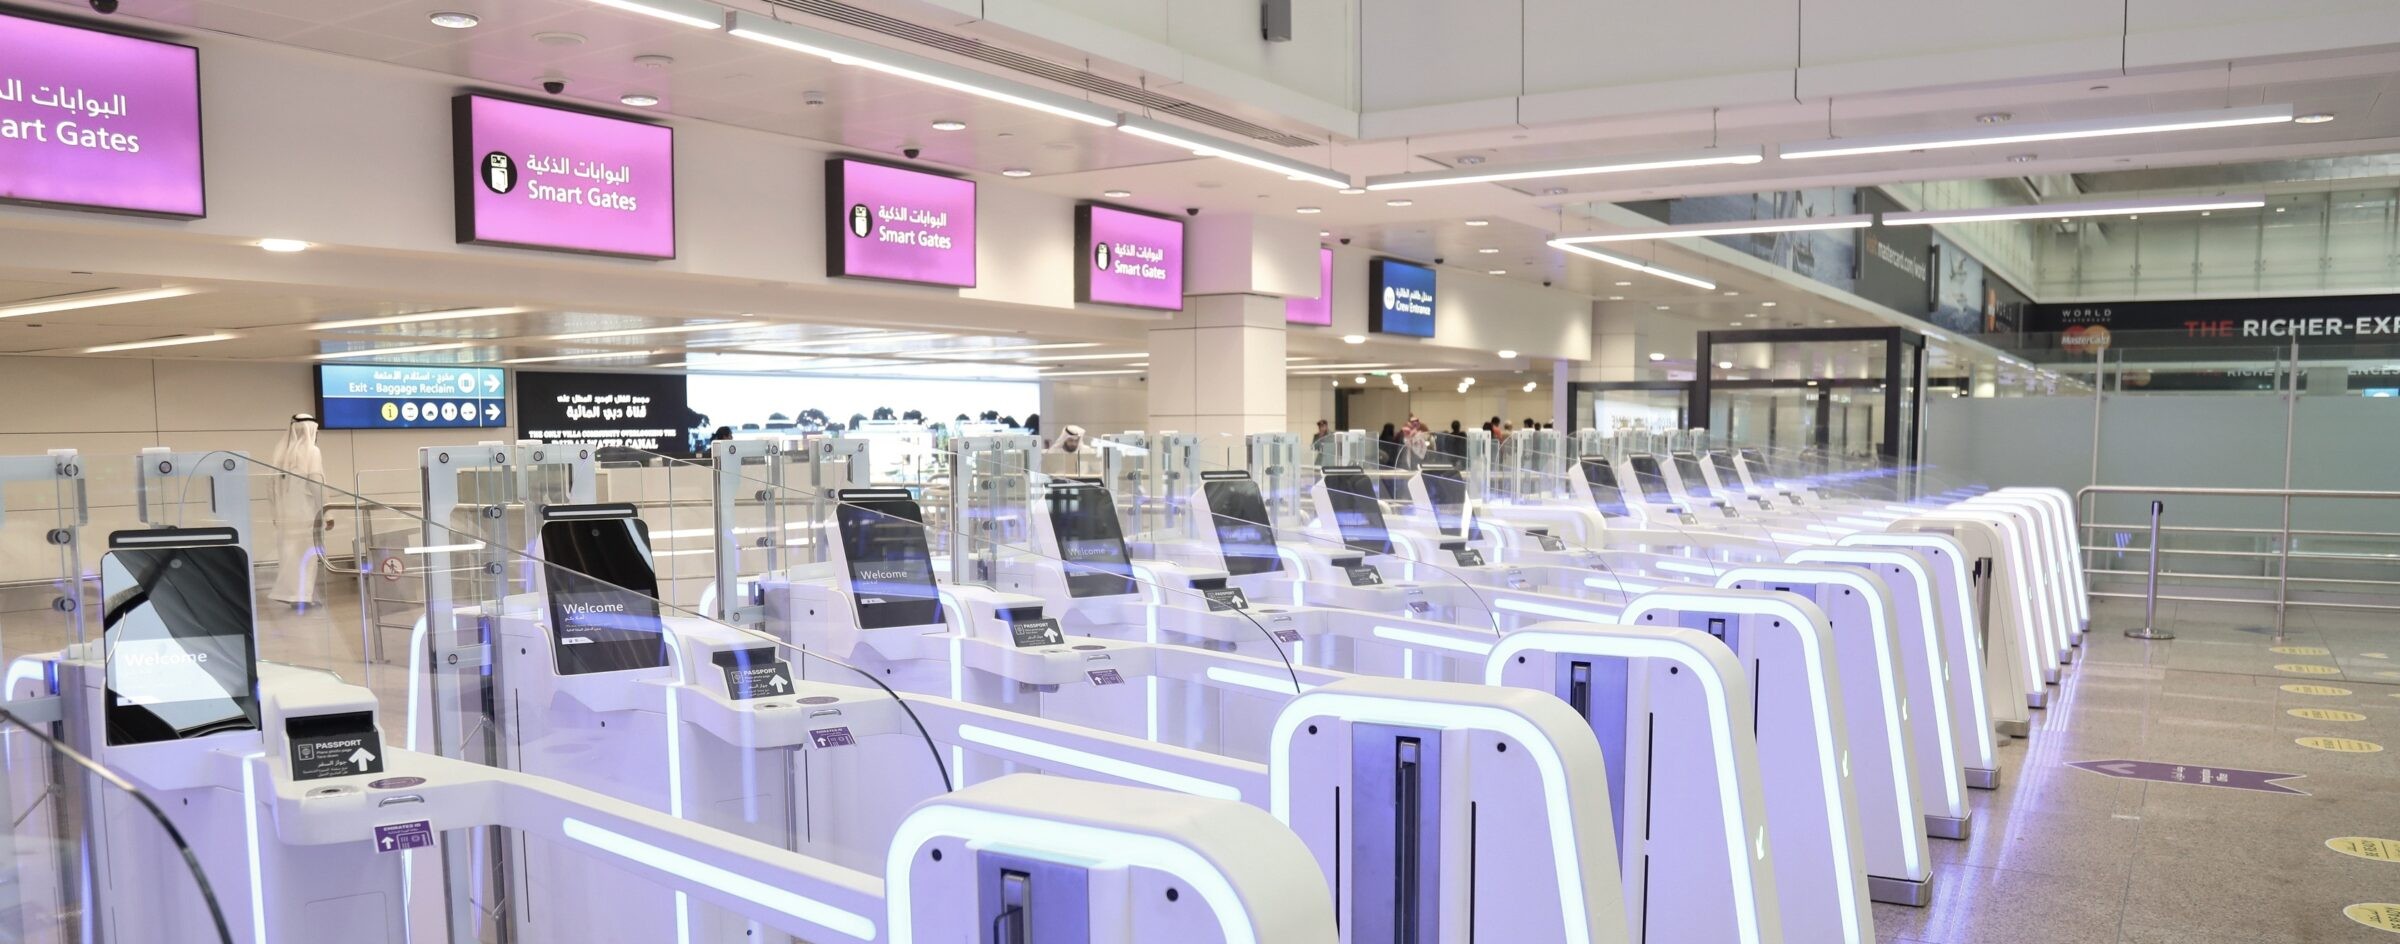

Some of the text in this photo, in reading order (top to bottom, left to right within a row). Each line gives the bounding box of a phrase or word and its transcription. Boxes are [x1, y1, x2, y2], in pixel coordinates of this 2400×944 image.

[31, 86, 126, 119] البوابات
[1, 118, 140, 153] art Gates
[526, 154, 630, 186] البوابات الذكية
[527, 179, 637, 211] Smart Gates
[878, 205, 947, 229] البوابات الذكية
[879, 225, 952, 250] Smart Gates
[1114, 259, 1166, 280] Smart Gates
[2061, 308, 2112, 318] WORLD
[2184, 320, 2235, 338] THE
[349, 382, 368, 393] Exit
[376, 383, 417, 396] Baggage
[420, 384, 455, 394] Reclaim
[528, 430, 543, 439] THE
[624, 438, 659, 450] CANAL
[860, 569, 908, 580] Welcome
[563, 602, 624, 615] Welcome
[125, 651, 208, 667] Welcome
[743, 667, 777, 676] PASSPORT
[315, 739, 362, 750] PASSPORT
